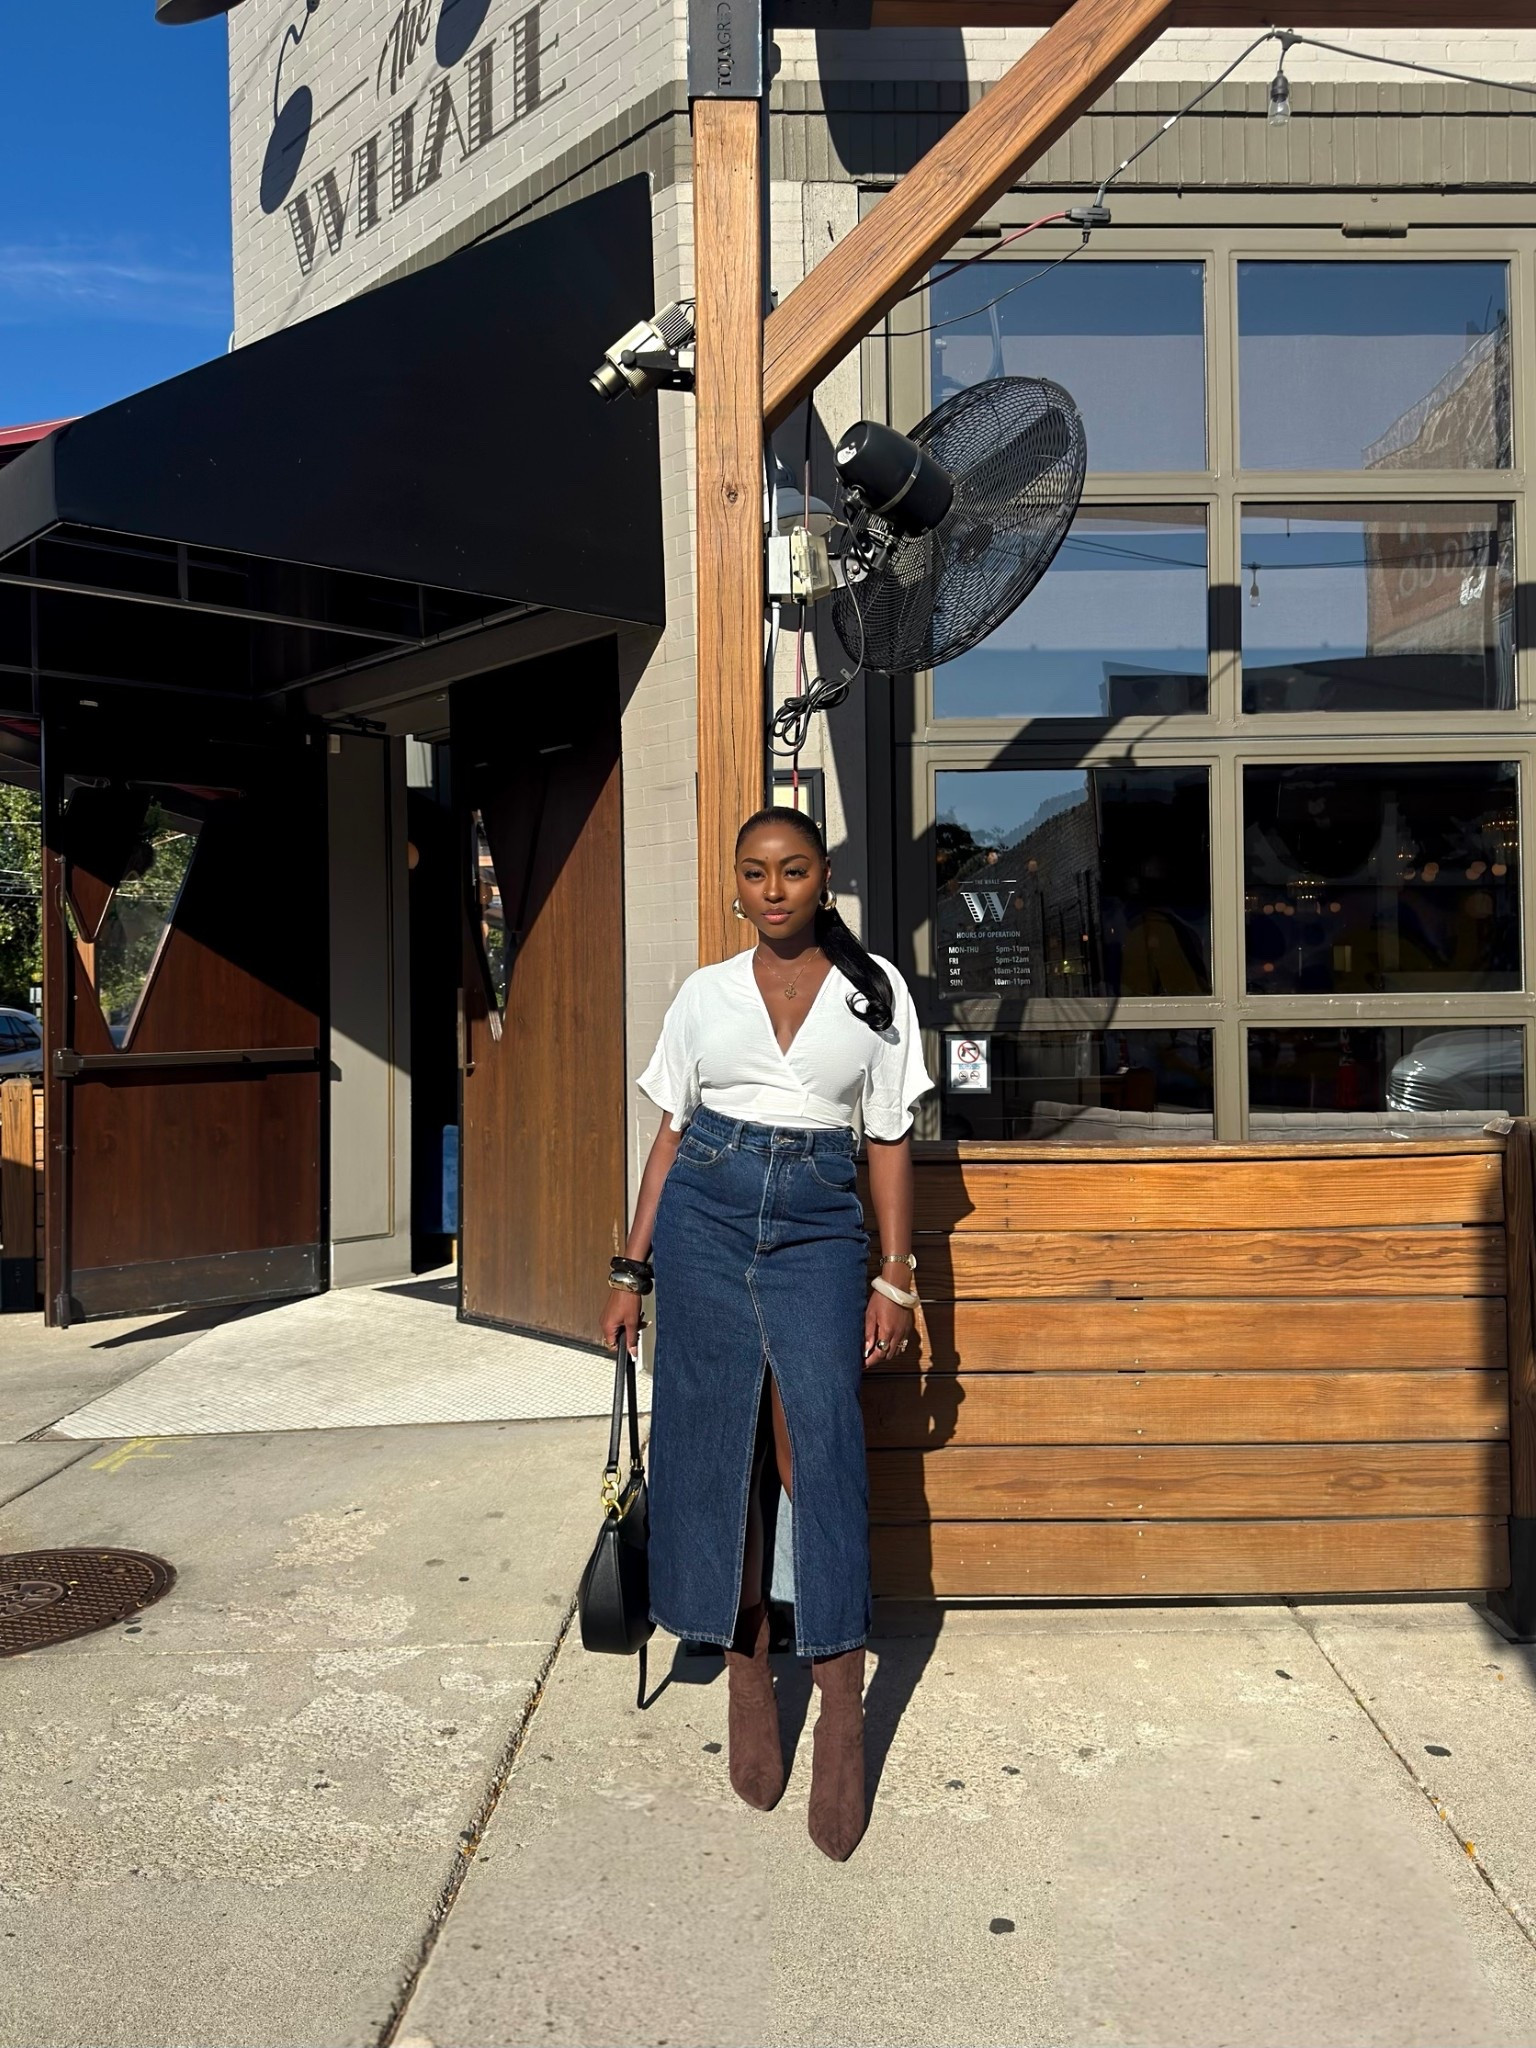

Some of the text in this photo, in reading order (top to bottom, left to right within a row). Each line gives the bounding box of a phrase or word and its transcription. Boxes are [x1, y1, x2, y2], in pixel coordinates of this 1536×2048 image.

[284, 3, 566, 277] WHALE
[960, 890, 1015, 923] W
[956, 931, 977, 939] HOURS
[987, 930, 1021, 938] OPERATION
[948, 945, 1030, 954] MON-THU 5pm-11pm
[948, 956, 1029, 965] FRI 5pm-12am
[949, 968, 961, 976] SAT
[949, 978, 1031, 987] SUN 10am-11pm
